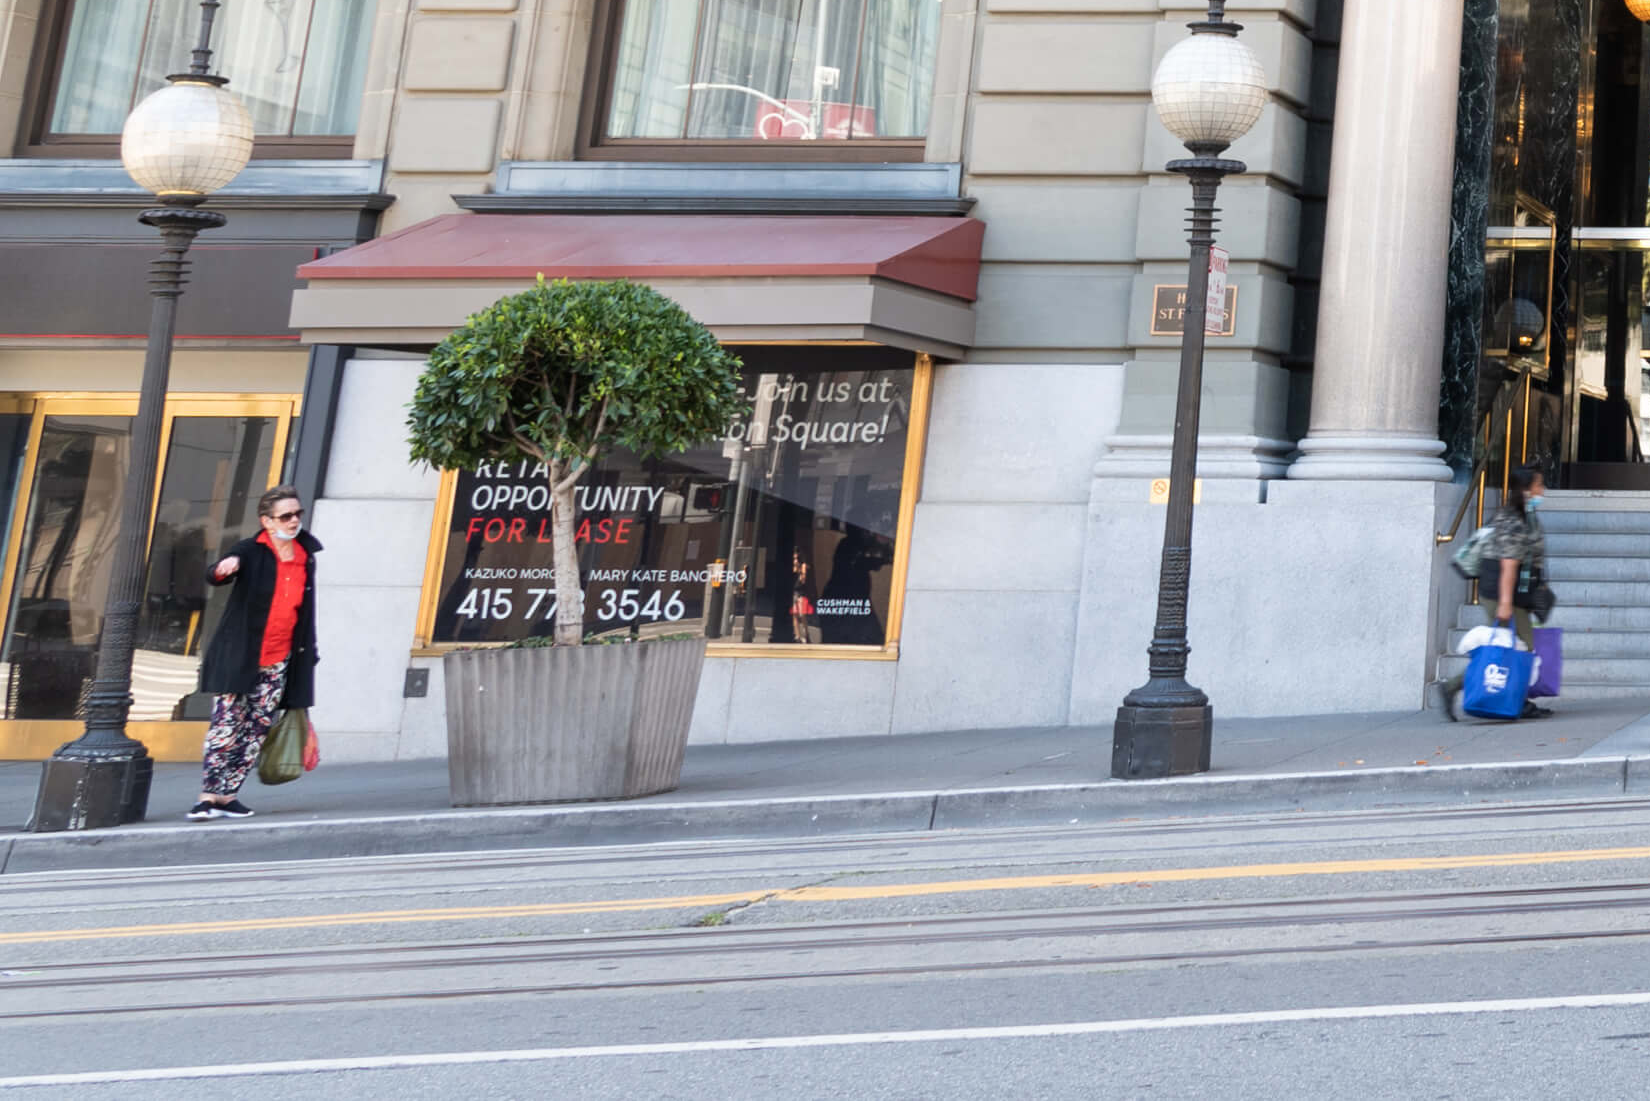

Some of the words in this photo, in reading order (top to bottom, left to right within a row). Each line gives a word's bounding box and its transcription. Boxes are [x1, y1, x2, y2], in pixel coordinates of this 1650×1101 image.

[817, 382, 850, 402] us
[858, 377, 892, 402] at
[771, 414, 889, 450] Square!
[471, 485, 664, 511] OPPOUNITY
[465, 517, 526, 543] FOR
[536, 517, 633, 544] LASE
[465, 568, 518, 579] KAZUKO
[588, 569, 629, 581] MARY
[632, 570, 666, 582] KATE
[670, 570, 748, 583] BANCHERO
[456, 588, 512, 619] 415
[524, 588, 585, 619] 77
[597, 588, 686, 621] 3546
[816, 599, 863, 607] CUSHMAN
[816, 607, 871, 615] WAKEFIELD
